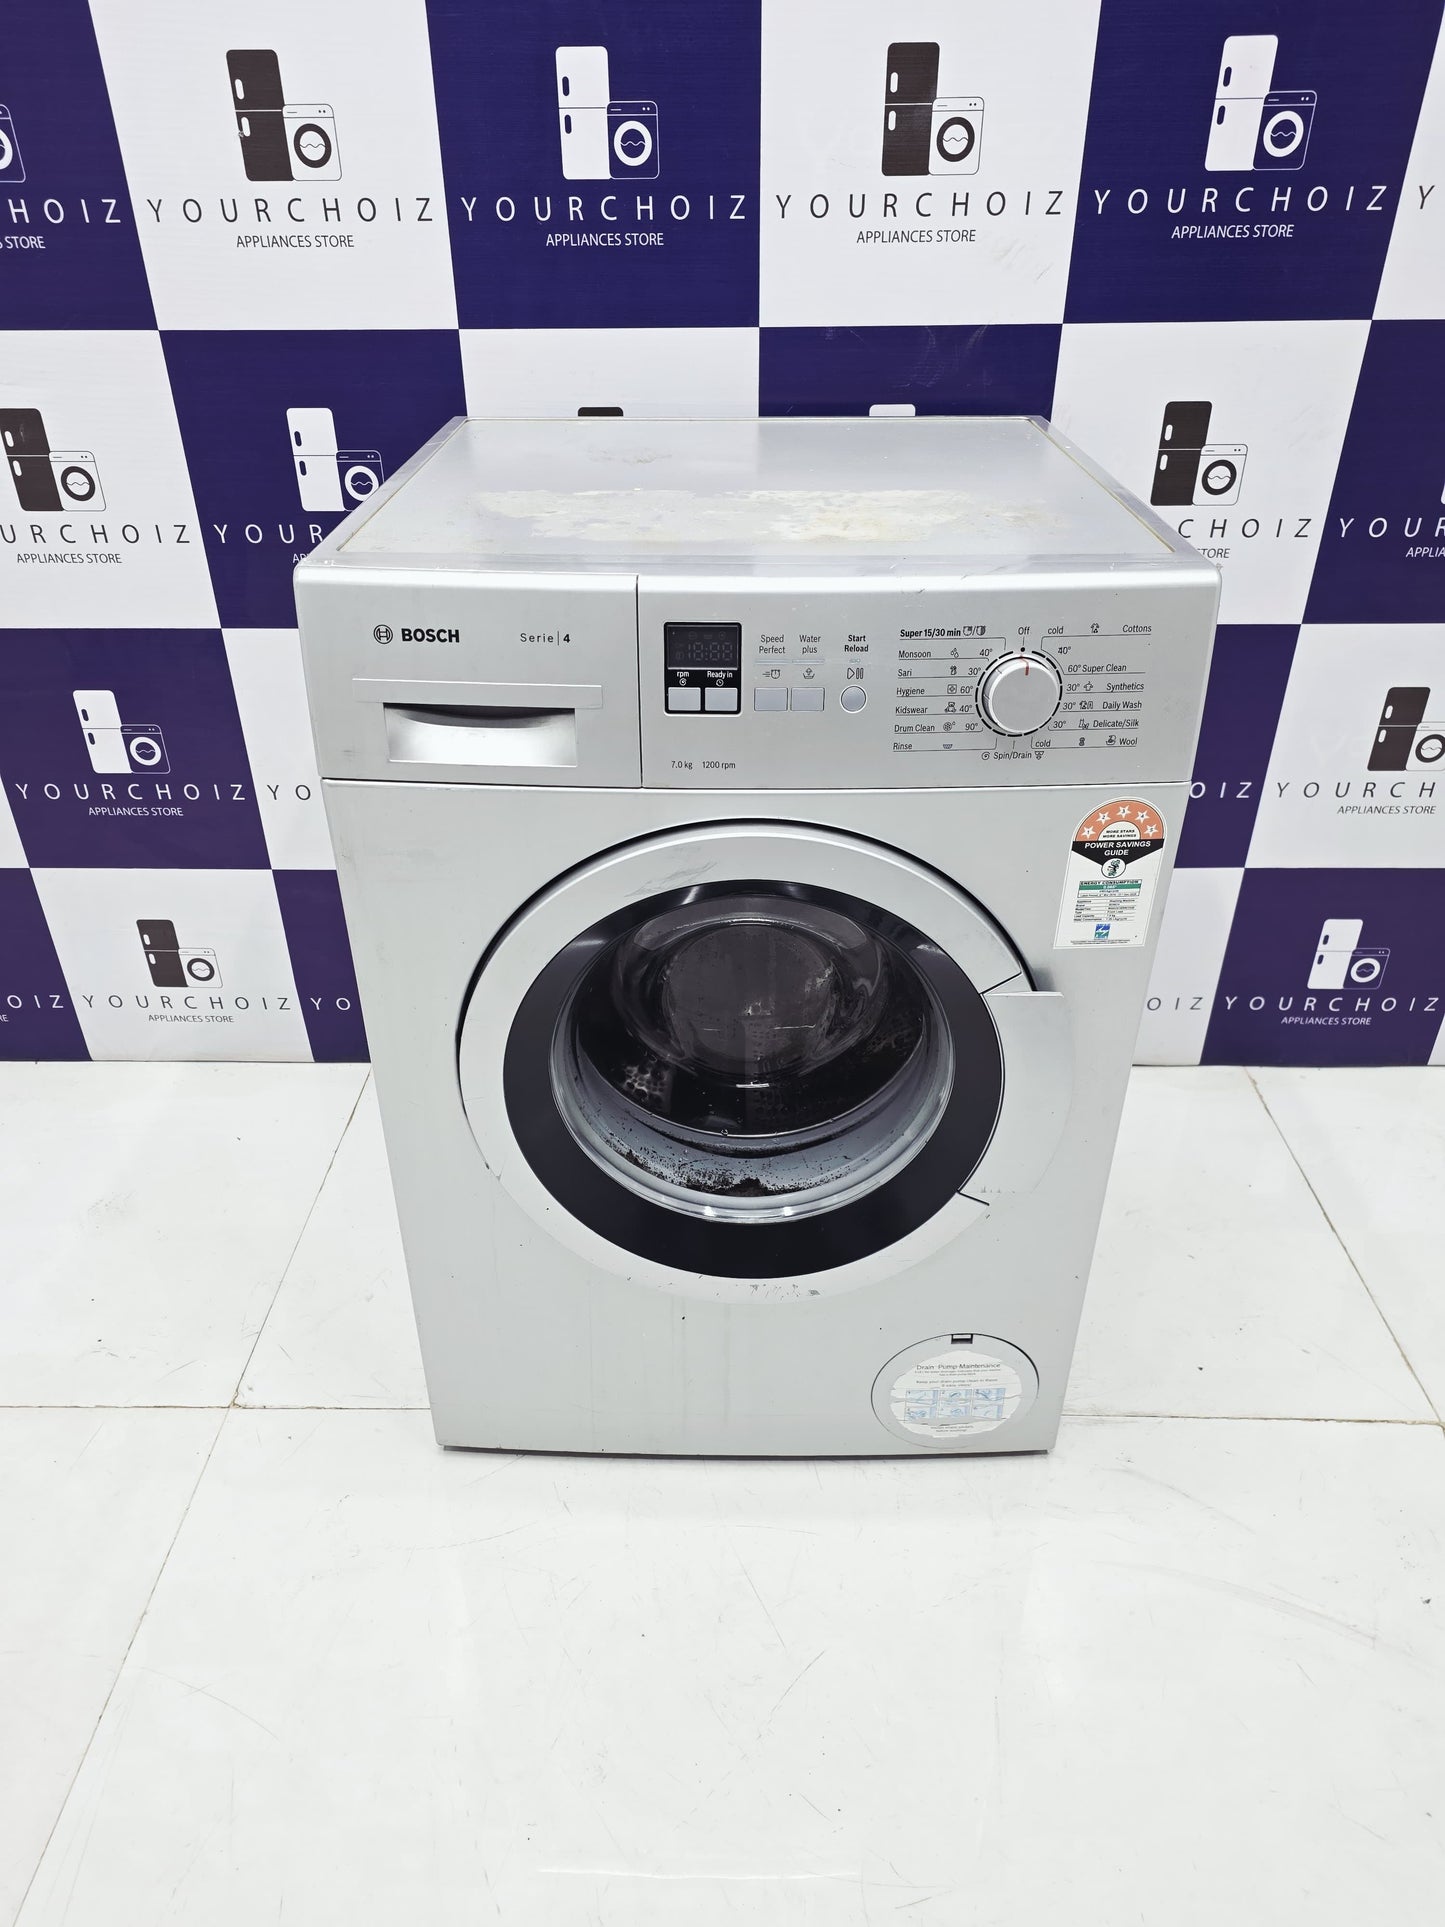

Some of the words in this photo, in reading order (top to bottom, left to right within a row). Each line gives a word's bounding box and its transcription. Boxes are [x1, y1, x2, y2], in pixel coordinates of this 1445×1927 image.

[776, 190, 1063, 219] YOURCHOIZ
[1094, 185, 1386, 214] YOURCHOIZ
[147, 198, 433, 223] YOURCHOIZ
[461, 195, 746, 222] YOURCHOIZ
[856, 229, 932, 244] APPLIANCES
[936, 228, 976, 242] STORE
[1171, 225, 1247, 239] APPLIANCES
[1251, 224, 1294, 238] STORE
[4, 235, 46, 249] STORE
[236, 235, 311, 249] APPLIANCES
[315, 235, 354, 249] STORE
[545, 233, 621, 248] APPLIANCES
[625, 232, 664, 247] STORE
[17, 553, 84, 564] APPLIANCES
[87, 553, 122, 564] STORE
[1197, 548, 1231, 559] TORE
[900, 629, 922, 638] Super
[924, 629, 946, 637] 15/30
[946, 629, 961, 637] min
[1018, 626, 1030, 636] Off
[1048, 626, 1064, 635] cold
[1122, 624, 1152, 633] Cottons
[401, 628, 460, 643] BOSCH
[520, 633, 554, 643] Serie
[563, 634, 571, 643] 4
[760, 634, 784, 645] Speed
[799, 634, 821, 643] Water
[848, 634, 866, 643] Start
[758, 645, 786, 654] Perfect
[802, 645, 818, 655] plus
[844, 644, 869, 653] Reload
[898, 650, 931, 658] Monsoon
[898, 668, 912, 677] Sari
[1082, 664, 1104, 674] Super
[1106, 664, 1127, 672] Clean
[676, 671, 690, 679] rpm
[706, 670, 727, 680] Ready
[896, 688, 925, 696] Hygiene
[1106, 682, 1144, 692] Synthetics
[895, 706, 928, 714] Kidswear
[1102, 702, 1121, 711] Daily
[1122, 700, 1142, 709] Wash
[894, 724, 910, 732] Drum
[911, 724, 935, 732] Clean
[1092, 719, 1139, 728] Delicate/Silk
[893, 742, 912, 750] Rinse
[1035, 740, 1051, 748] cold
[1119, 737, 1138, 746] Wool
[993, 751, 1032, 760] Spin/Drain
[670, 761, 683, 769] 7.0
[683, 761, 693, 770] kg
[702, 760, 720, 769] 1200
[720, 762, 736, 770] rpm
[16, 784, 246, 801] YOURCHOIZ
[88, 806, 148, 817] APPLIANCES
[151, 806, 184, 817] STORE
[1336, 806, 1400, 815] APPLIANCES
[1402, 806, 1436, 815] STORE
[1116, 840, 1151, 848] SAVINGS
[82, 995, 290, 1010] YOURCHOIZ
[1225, 996, 1439, 1012] YOURCHOIZ
[148, 1014, 202, 1024] APPLIANCES
[205, 1014, 234, 1024] STORE
[1281, 1016, 1338, 1026] APPLIANCES
[1341, 1016, 1372, 1026] STORE
